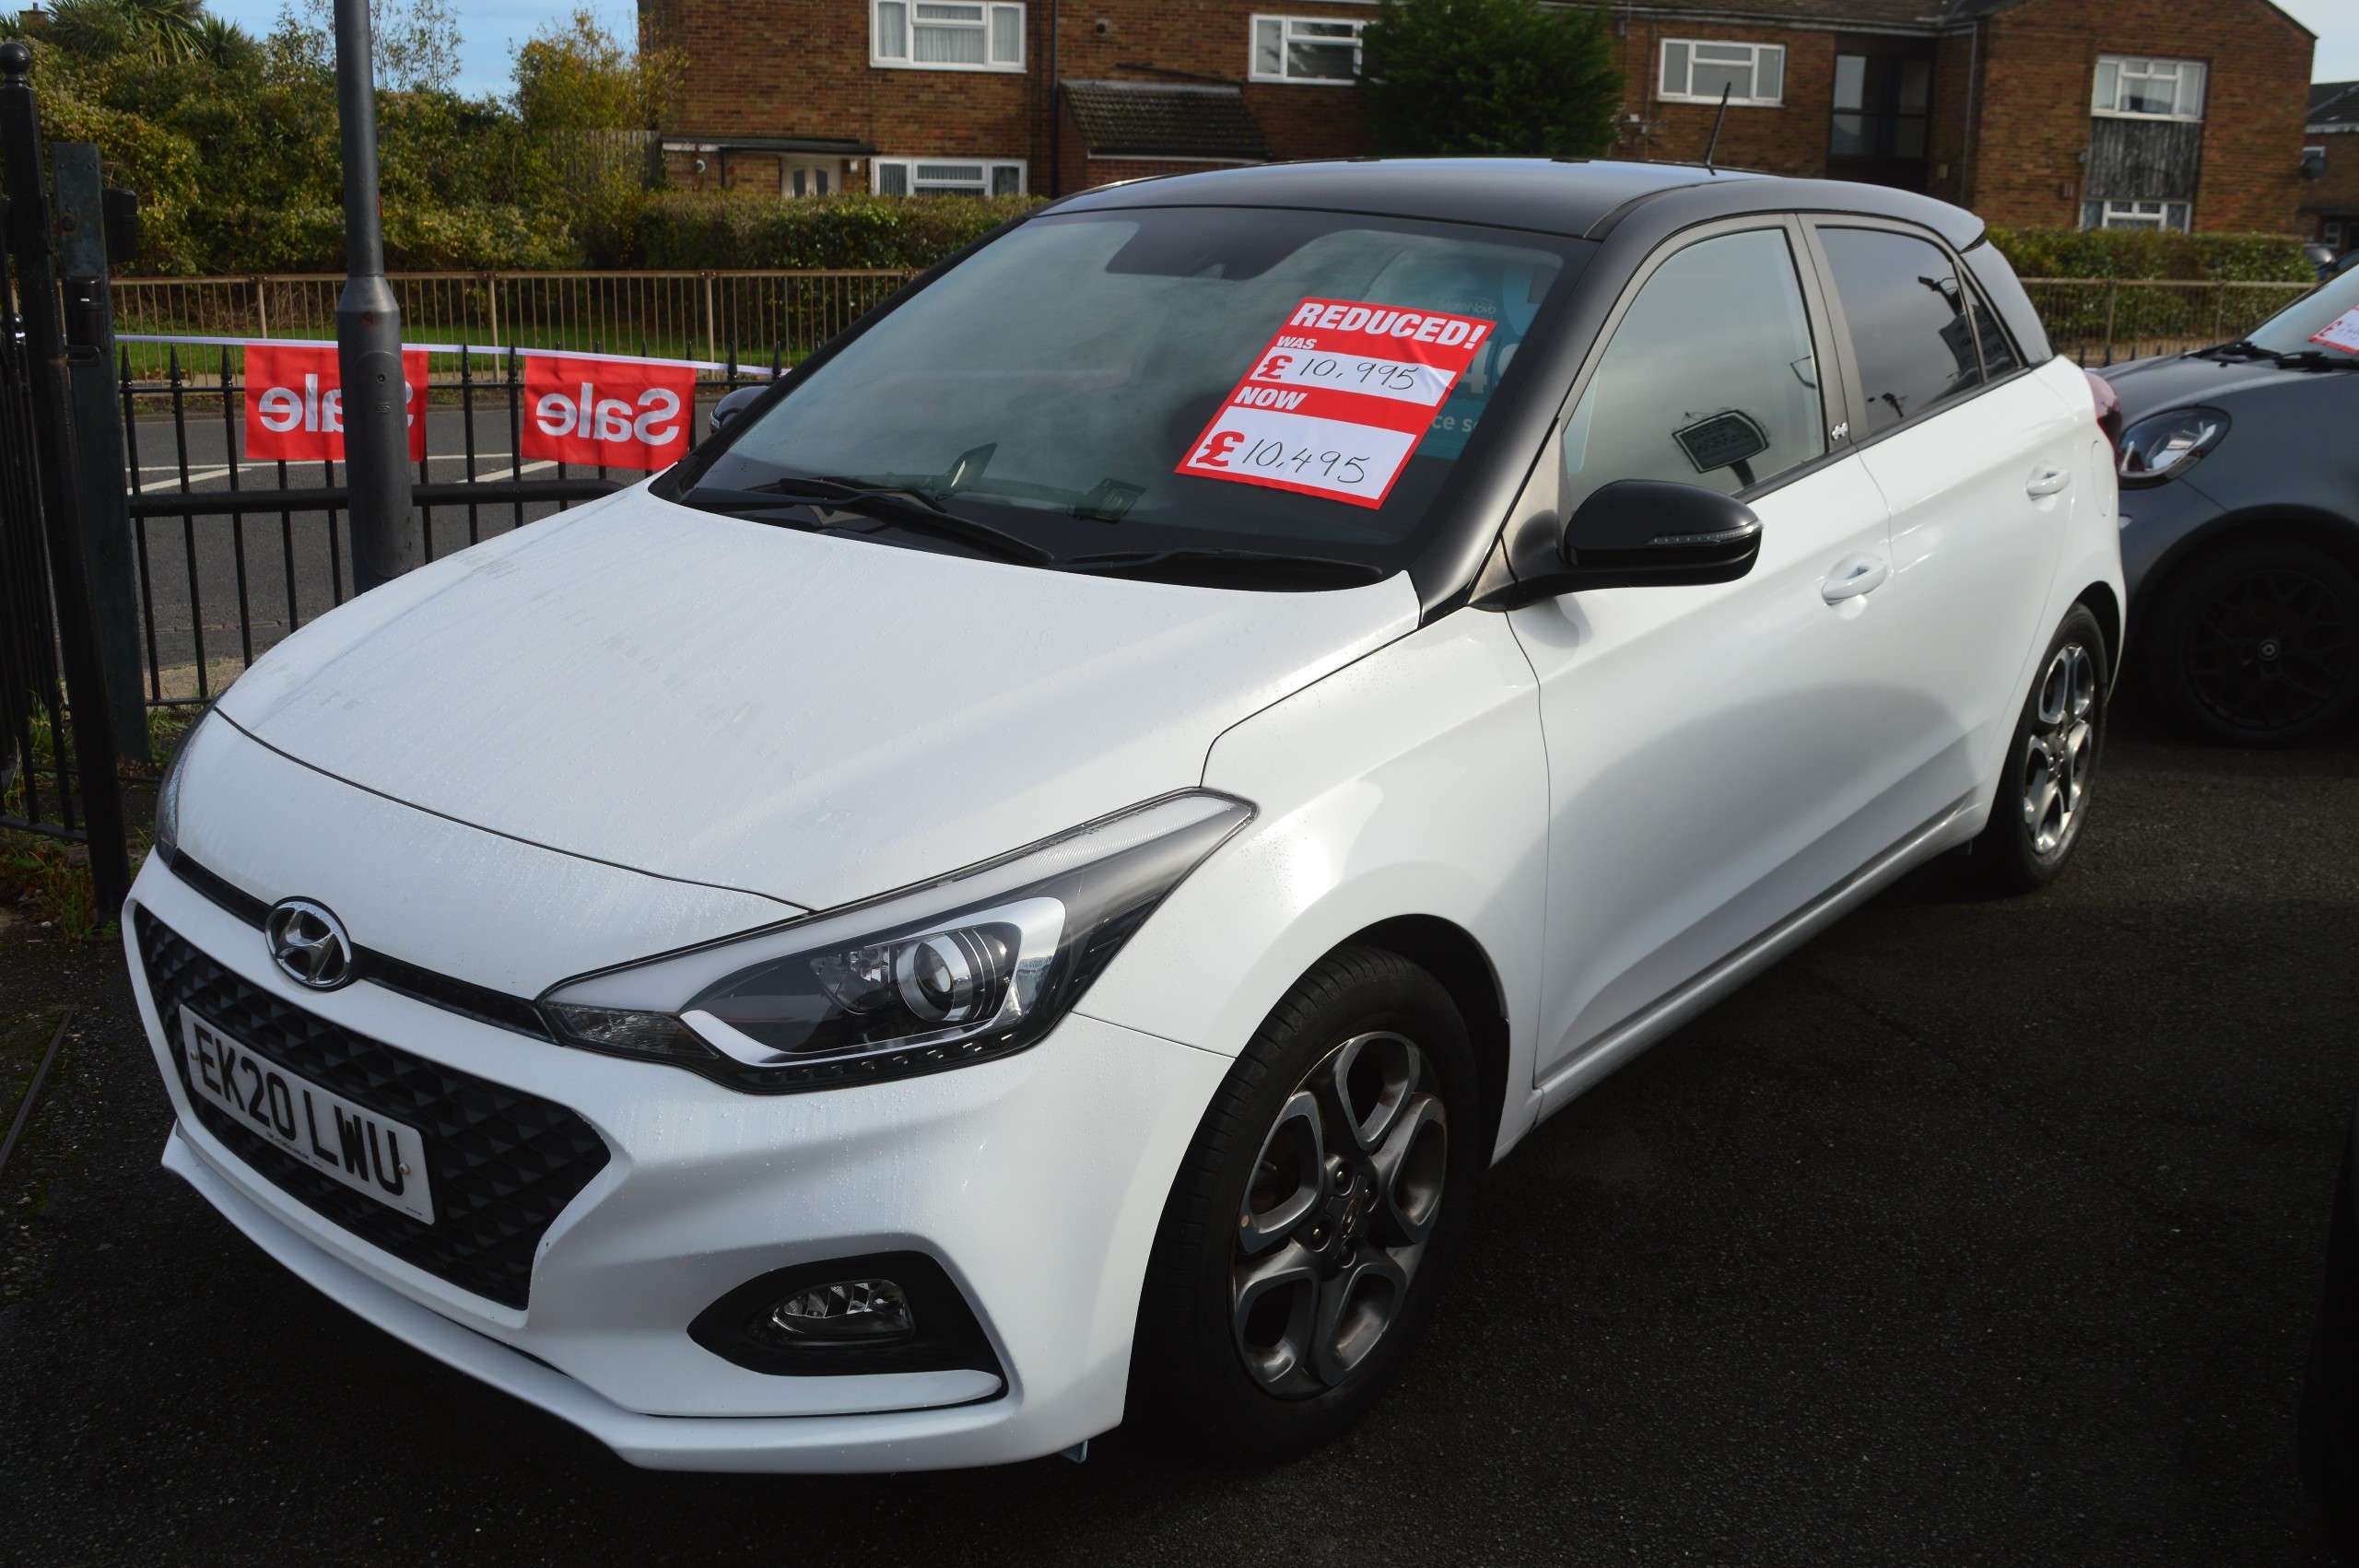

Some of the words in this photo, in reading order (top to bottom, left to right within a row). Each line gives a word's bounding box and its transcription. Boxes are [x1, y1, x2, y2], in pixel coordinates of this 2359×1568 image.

[1276, 335, 1317, 350] WAS
[1290, 302, 1486, 349] REDUCED!
[1233, 386, 1307, 411] NOW
[194, 1022, 297, 1141] EK20
[302, 1088, 405, 1197] LWU
